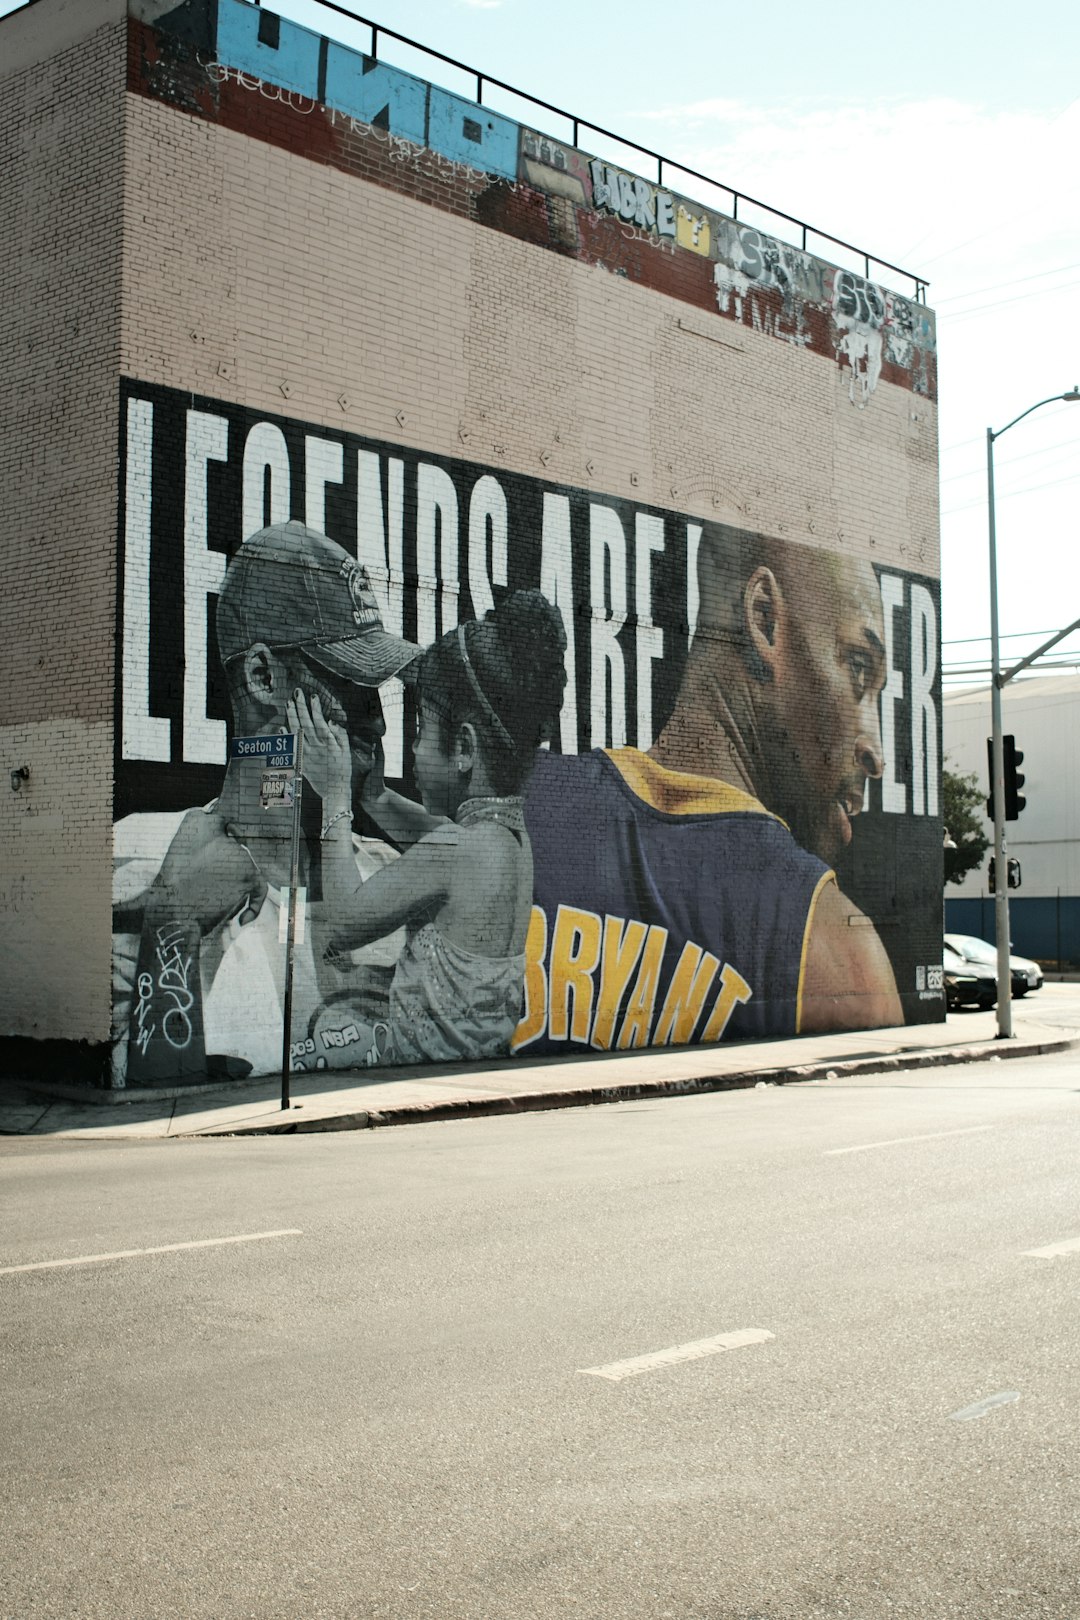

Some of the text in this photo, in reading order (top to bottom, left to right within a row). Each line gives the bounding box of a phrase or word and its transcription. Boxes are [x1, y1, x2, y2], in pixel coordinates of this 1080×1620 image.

[539, 492, 665, 756] ARE
[237, 738, 287, 755] Seaton St
[270, 756, 283, 766] 400
[320, 1023, 360, 1050] NBA
